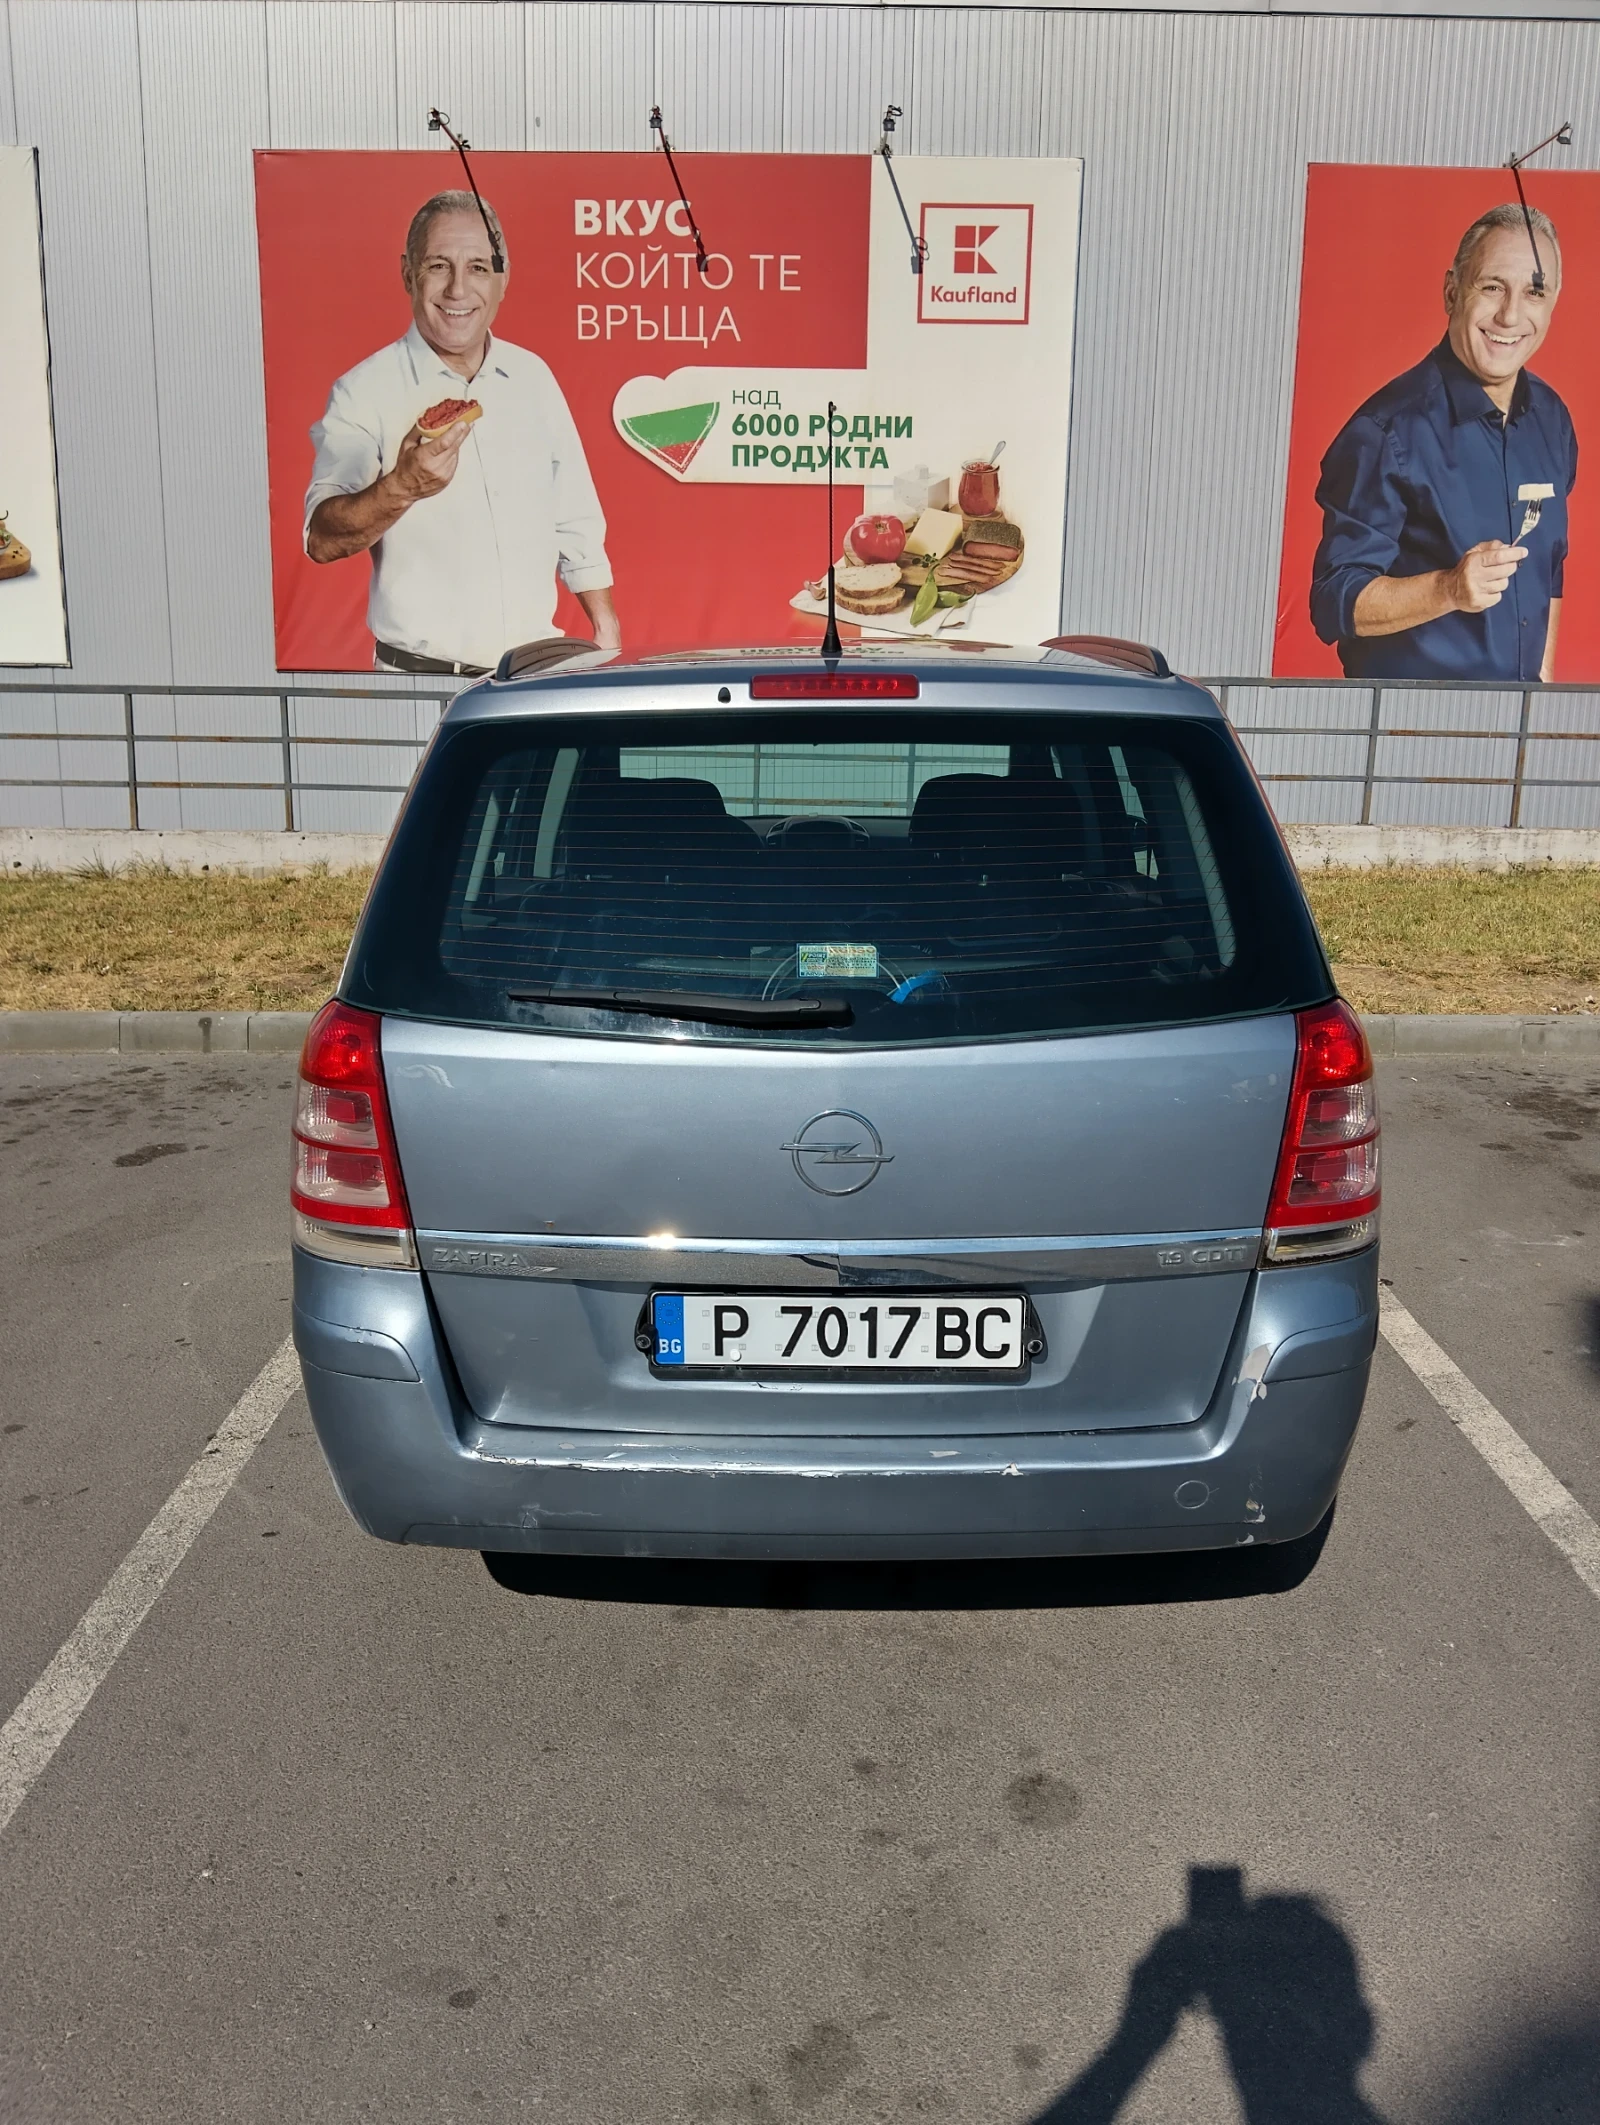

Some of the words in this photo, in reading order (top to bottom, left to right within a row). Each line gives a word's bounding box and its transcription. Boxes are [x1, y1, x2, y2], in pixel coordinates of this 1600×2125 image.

[576, 244, 733, 290] КОЙТО
[749, 254, 801, 291] ТЕ
[931, 285, 1017, 303] Kaufland
[577, 304, 741, 349] ВРЪЩА
[732, 389, 781, 410] над
[731, 413, 800, 437] 6000
[808, 415, 913, 442] РОДНИ
[732, 444, 889, 472] ПРОДУКТА
[433, 1248, 529, 1268] ZAFIRA
[714, 1305, 750, 1356] P
[659, 1338, 682, 1354] BG
